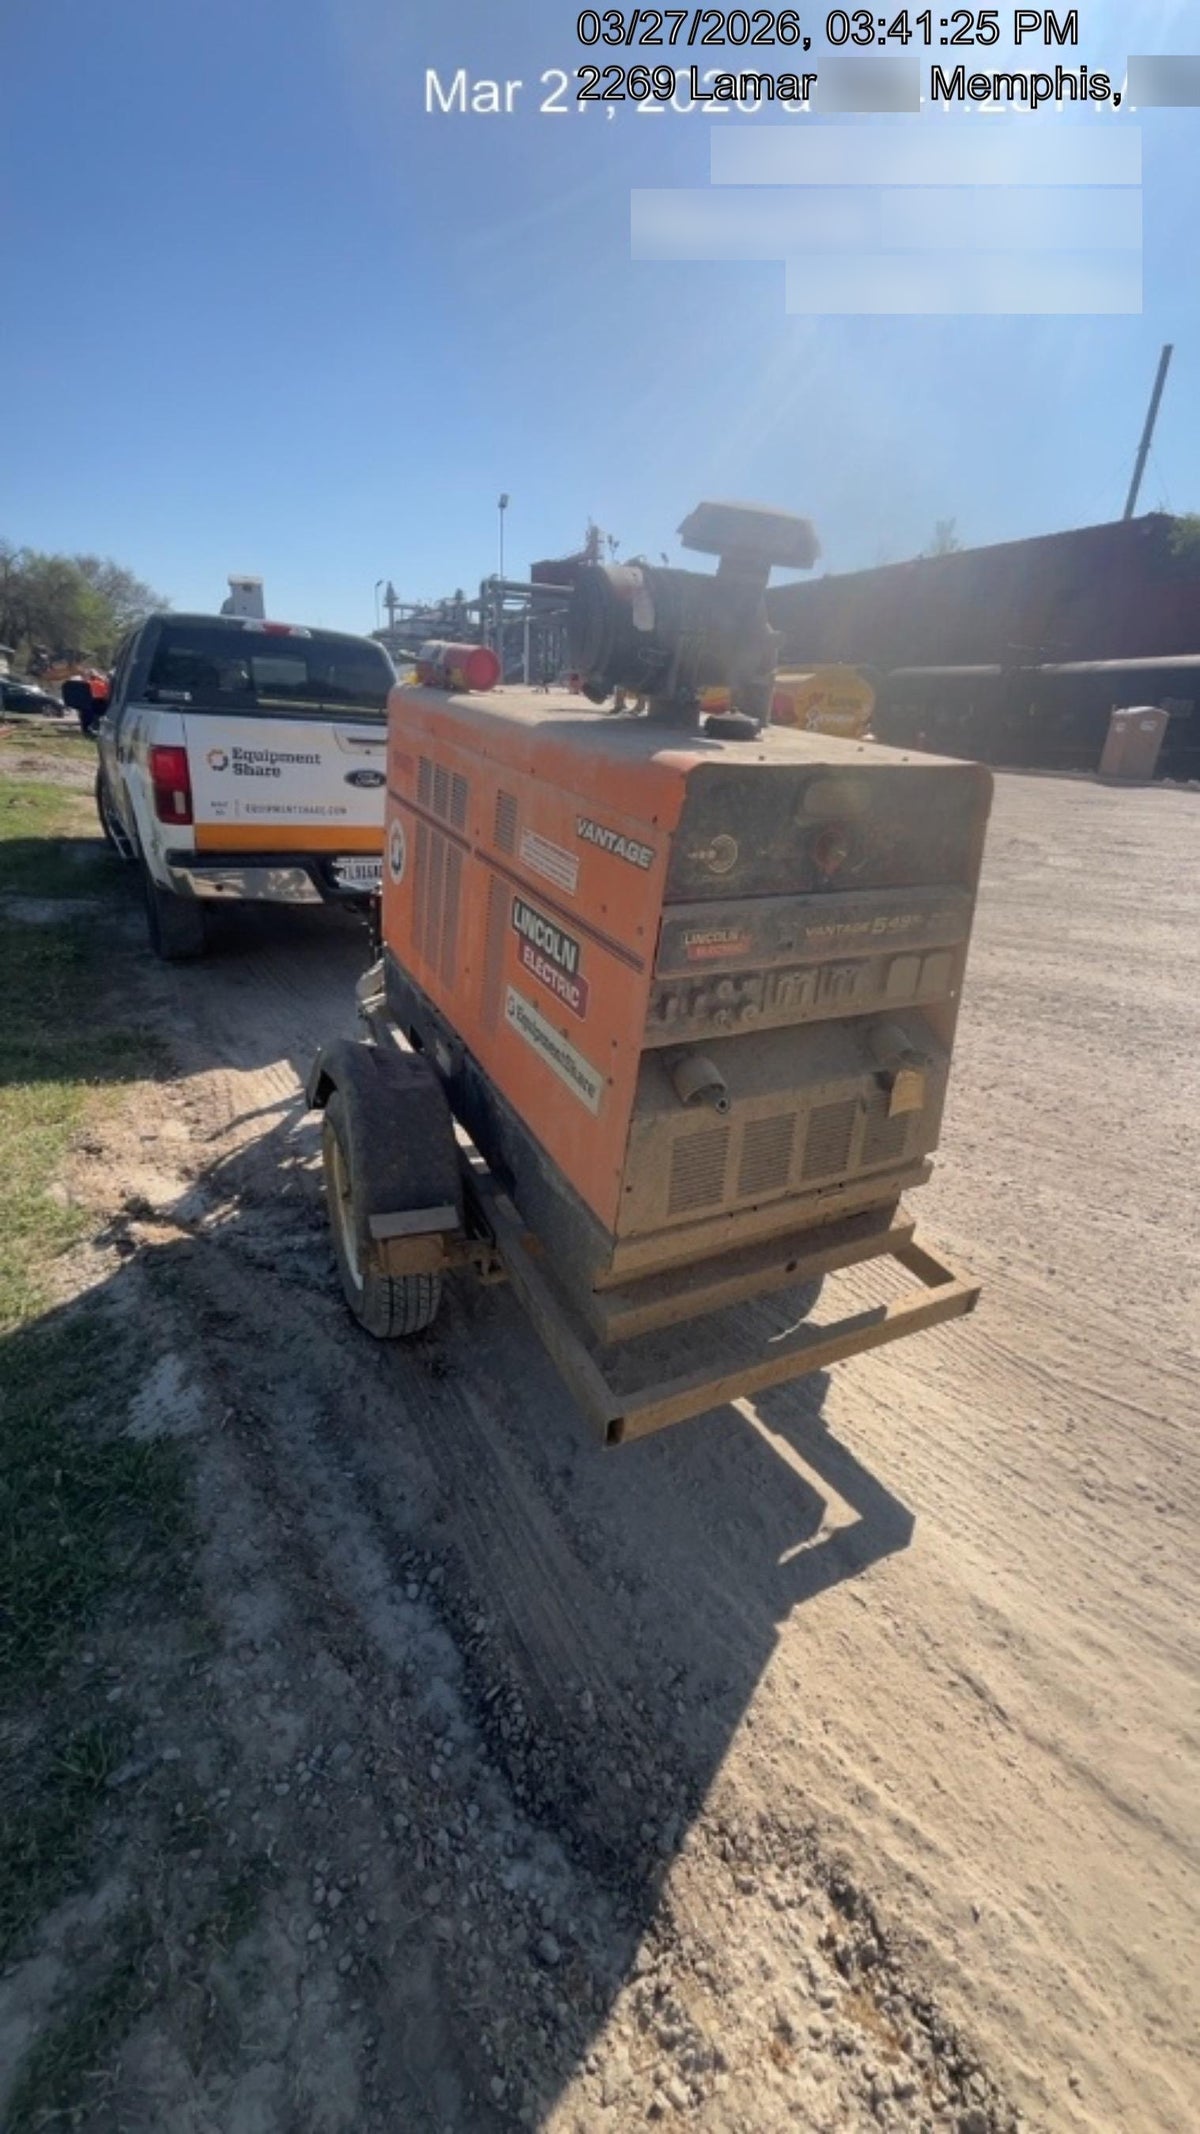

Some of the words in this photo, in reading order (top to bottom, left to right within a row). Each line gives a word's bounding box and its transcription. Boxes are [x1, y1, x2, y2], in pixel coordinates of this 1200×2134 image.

[231, 747, 322, 765] Equipment
[232, 763, 281, 778] Share
[576, 817, 654, 868] VANTAGE
[514, 901, 577, 974] LINCOLN
[684, 930, 739, 945] LINCOLN
[522, 944, 581, 1008] ELECTRIC
